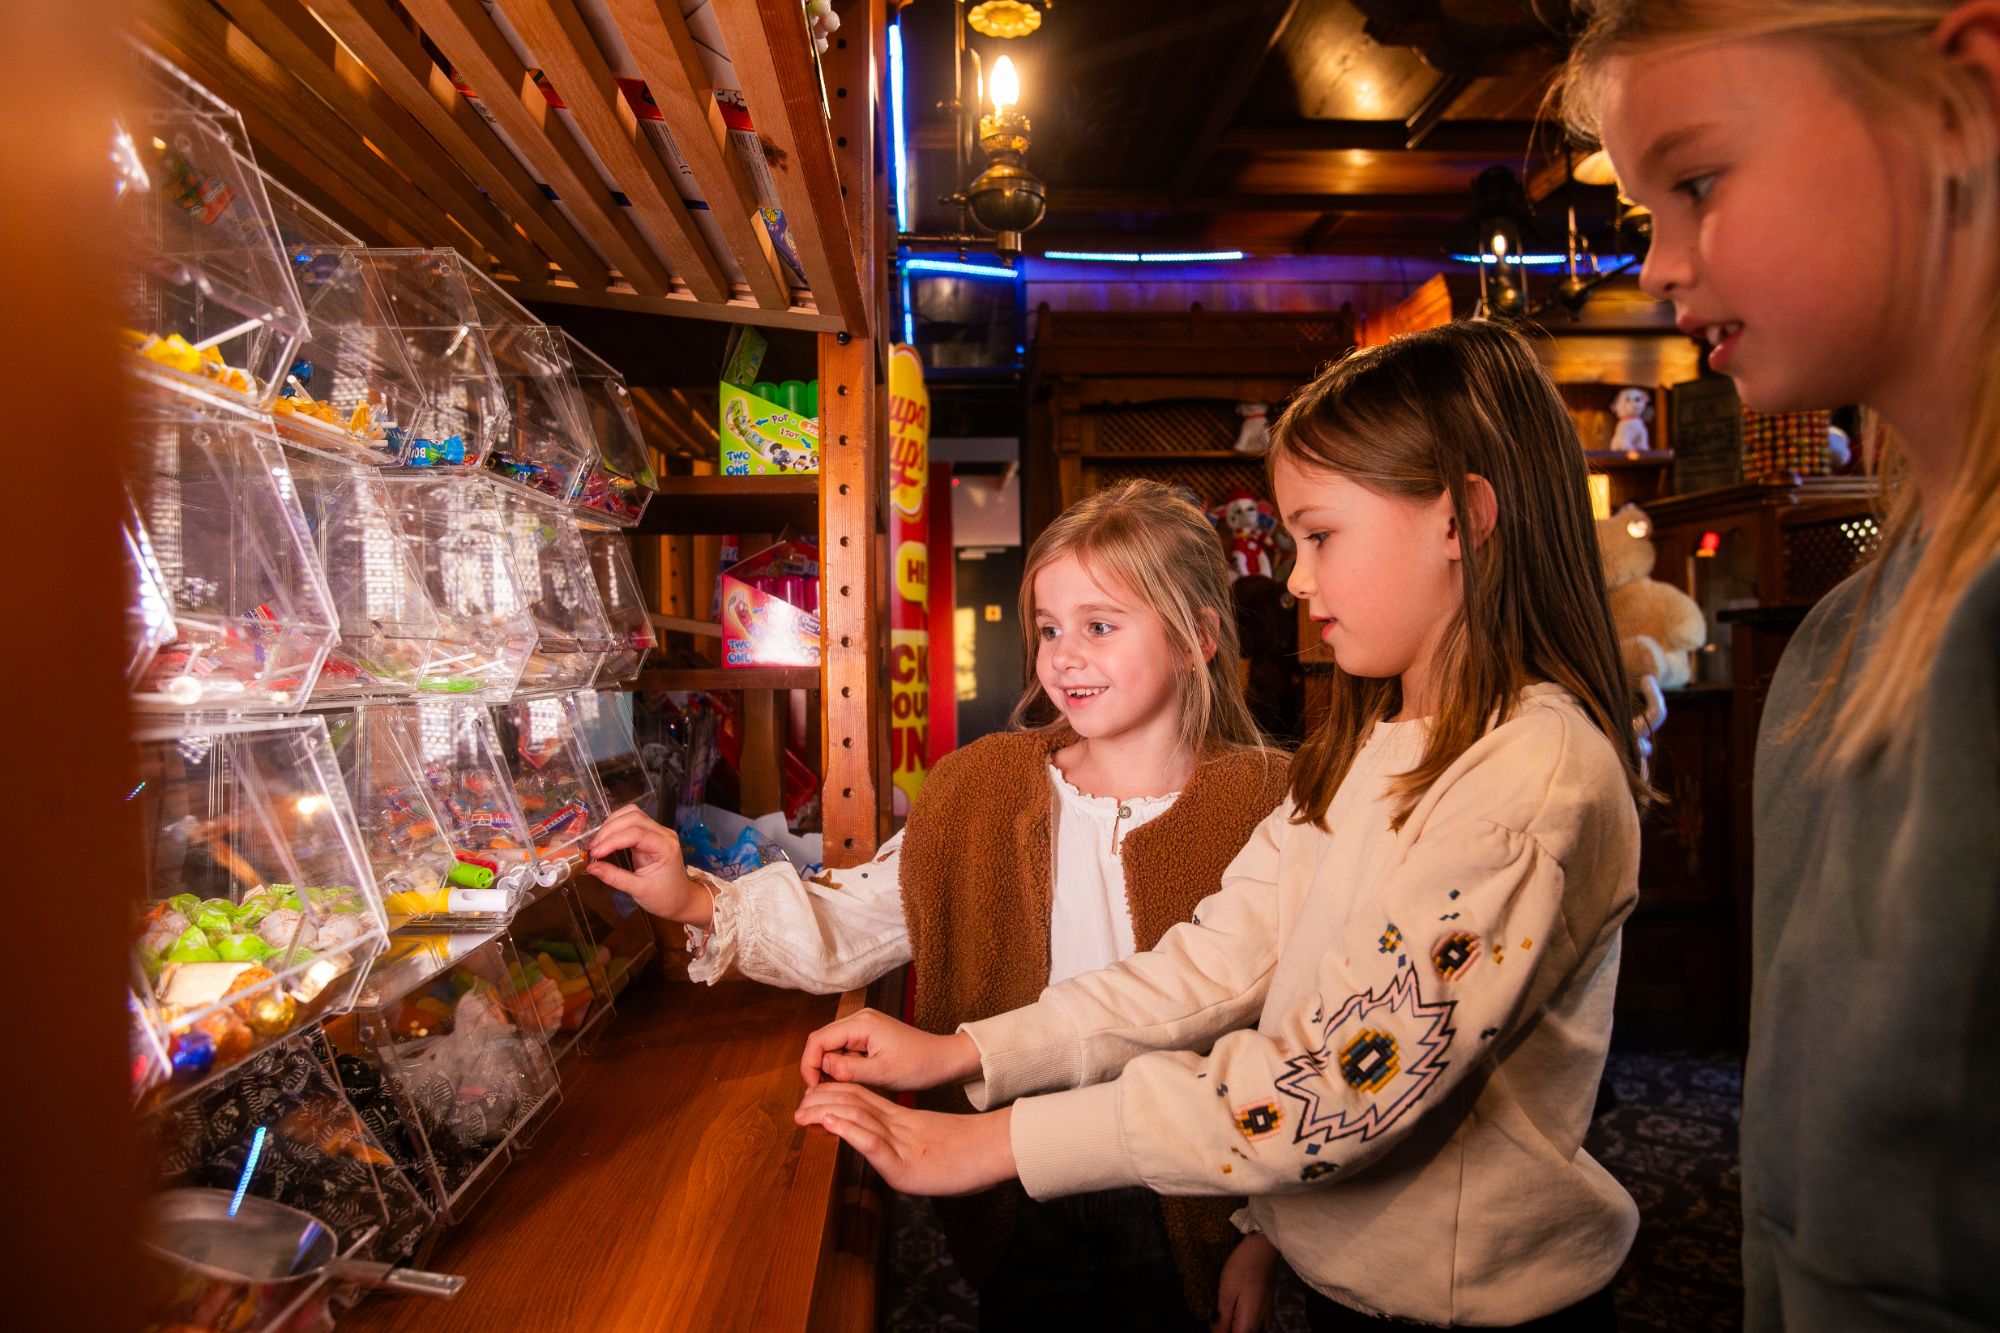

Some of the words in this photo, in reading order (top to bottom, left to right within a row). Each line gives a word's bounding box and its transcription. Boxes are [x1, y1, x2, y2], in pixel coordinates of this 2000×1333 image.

[770, 413, 789, 425] POP
[889, 395, 926, 434] upa
[786, 430, 800, 439] TOY
[726, 451, 751, 461] TWO
[725, 464, 750, 476] ONE
[728, 640, 751, 649] TWO
[727, 653, 751, 663] ONE
[891, 644, 928, 684] CK
[893, 692, 928, 720] OU
[892, 727, 928, 772] UN
